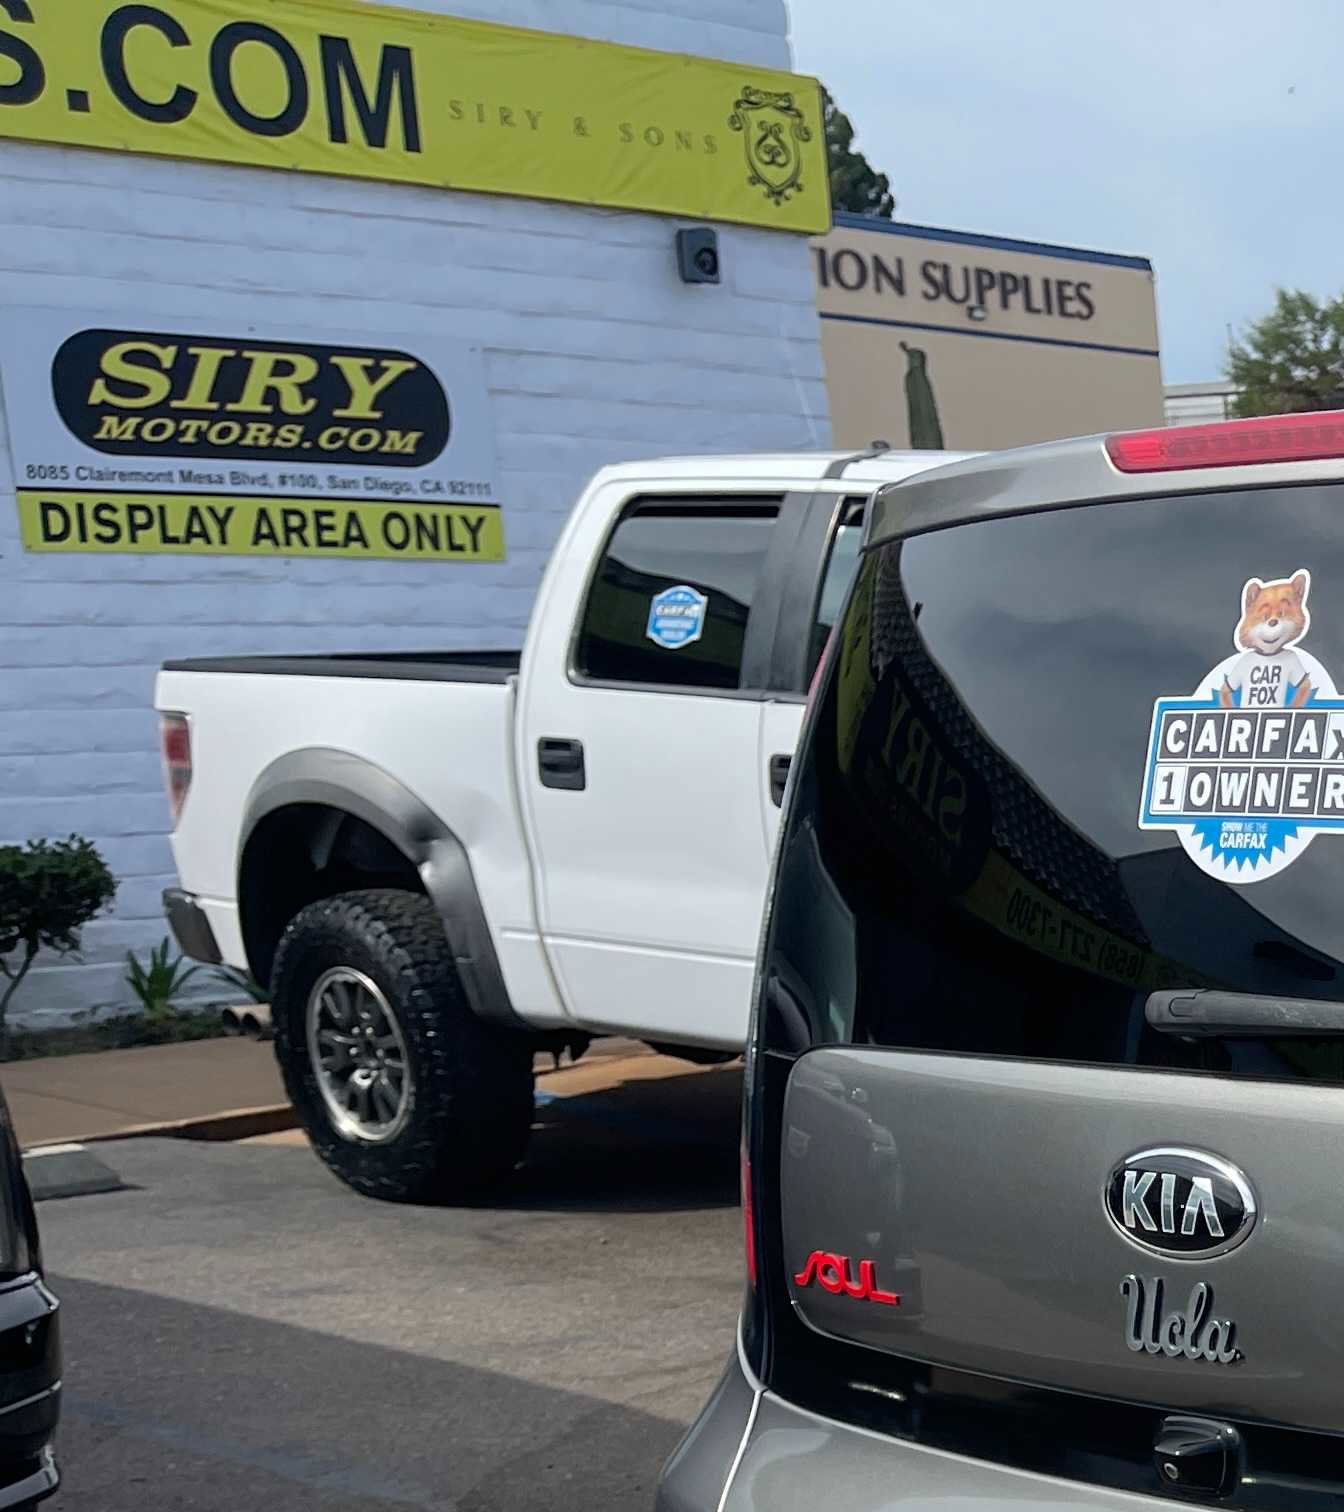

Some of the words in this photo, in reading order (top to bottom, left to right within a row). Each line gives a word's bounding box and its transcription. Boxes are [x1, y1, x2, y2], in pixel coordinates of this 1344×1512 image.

[449, 99, 543, 131] SIRY
[573, 116, 591, 138] &
[619, 122, 719, 155] SONS
[919, 260, 1096, 321] SUPPLIES
[88, 341, 417, 420] SIRY
[94, 415, 424, 455] MOTORS.COM
[26, 464, 70, 481] 8085
[75, 466, 174, 484] Clairemont
[179, 469, 225, 485] Mesa
[230, 471, 274, 489] Blvd,
[327, 475, 360, 491] San
[363, 477, 417, 496] Diego,
[420, 479, 443, 495] CA
[40, 502, 235, 546] DISPLAY
[251, 507, 369, 550] AREA
[383, 511, 486, 553] ONLY
[1247, 685, 1278, 705] FOX
[1249, 665, 1282, 685] CAR
[1159, 771, 1176, 805] 1
[1219, 832, 1268, 849] CARFAX
[1122, 1169, 1225, 1238] KIA
[794, 1250, 898, 1306] SOUL
